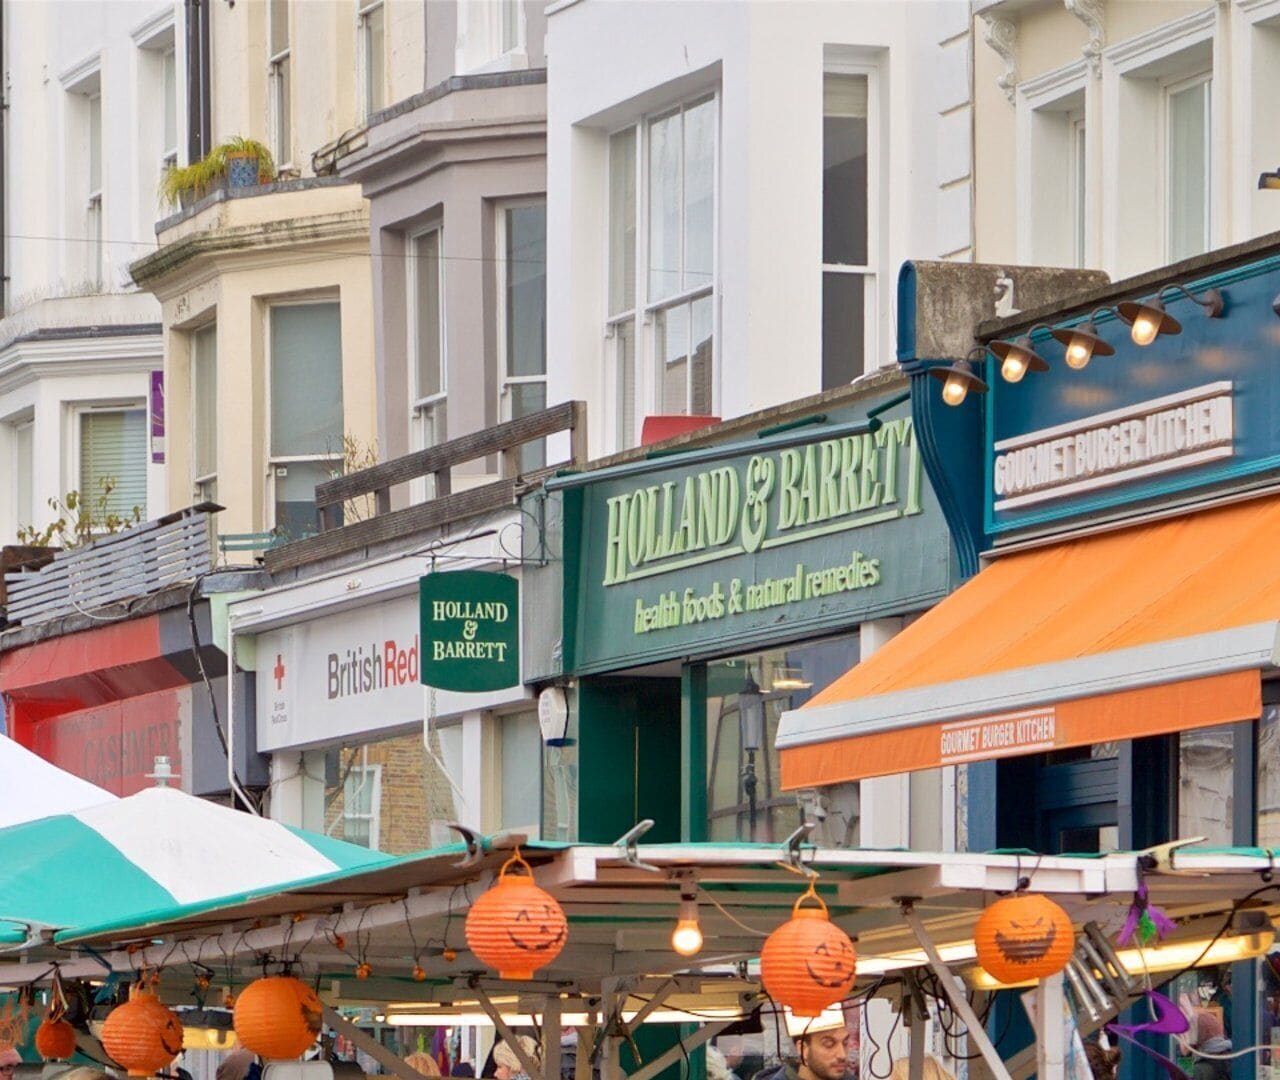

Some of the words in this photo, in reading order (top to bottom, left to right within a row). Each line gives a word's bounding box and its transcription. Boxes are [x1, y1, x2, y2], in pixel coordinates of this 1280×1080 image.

[994, 435, 1075, 495] GOURMET
[1075, 418, 1146, 476] BURGER
[1145, 396, 1233, 458] KITCHEN
[603, 465, 739, 587] HOLLAND
[741, 454, 776, 554] &
[778, 415, 924, 531] BARRETT
[432, 601, 508, 623] HOLLAND
[634, 589, 681, 634] health
[682, 580, 725, 623] foods
[727, 577, 744, 614] &
[746, 563, 802, 611] natural
[804, 550, 881, 598] remedies
[462, 620, 478, 640] &
[432, 641, 508, 662] BARRETT
[940, 727, 981, 755] GOURMET
[981, 721, 1015, 749] BURGER
[1016, 713, 1056, 745] KITCHEN
